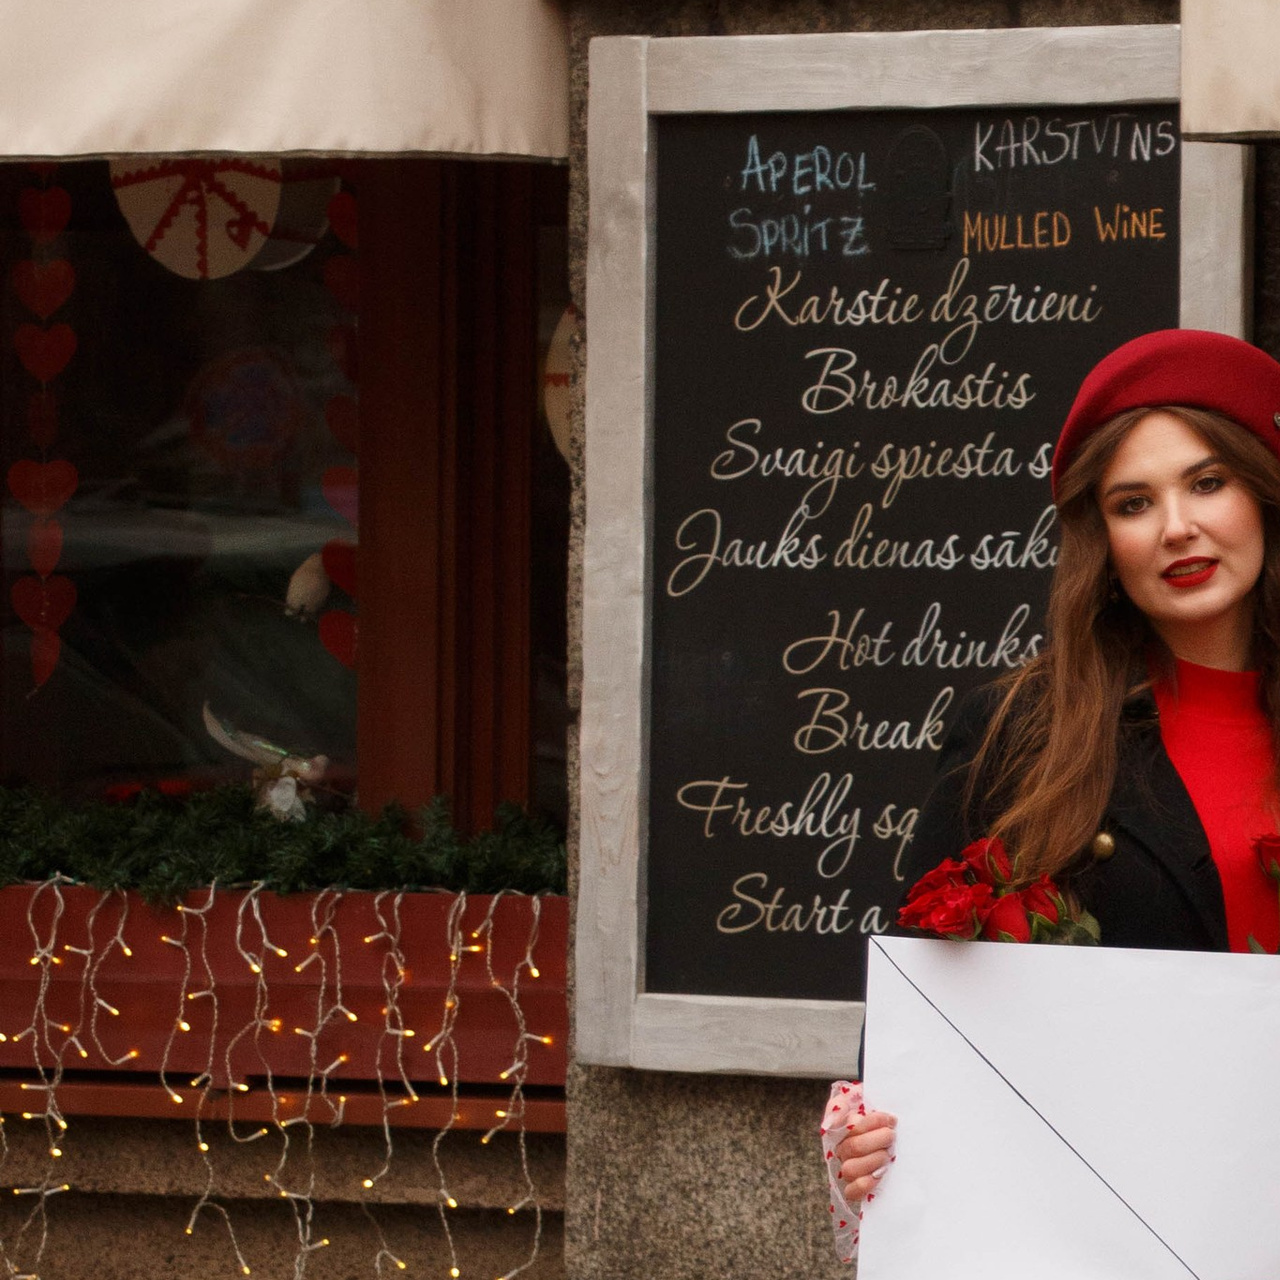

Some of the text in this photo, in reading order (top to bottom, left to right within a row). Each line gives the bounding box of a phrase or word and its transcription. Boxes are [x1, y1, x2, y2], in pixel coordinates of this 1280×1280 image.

[741, 134, 876, 195] APEROL
[963, 210, 1072, 256] MULLED
[735, 257, 1102, 365] Karstie dzērieni
[801, 346, 1035, 414] Brokastis
[710, 419, 865, 519] Svaigi
[871, 431, 1022, 509] spiesta
[667, 505, 827, 597] Jauks
[833, 502, 964, 570] dienas
[782, 602, 1045, 674] Hot drinks
[676, 772, 861, 879] Freshly
[716, 872, 889, 934] Start a
